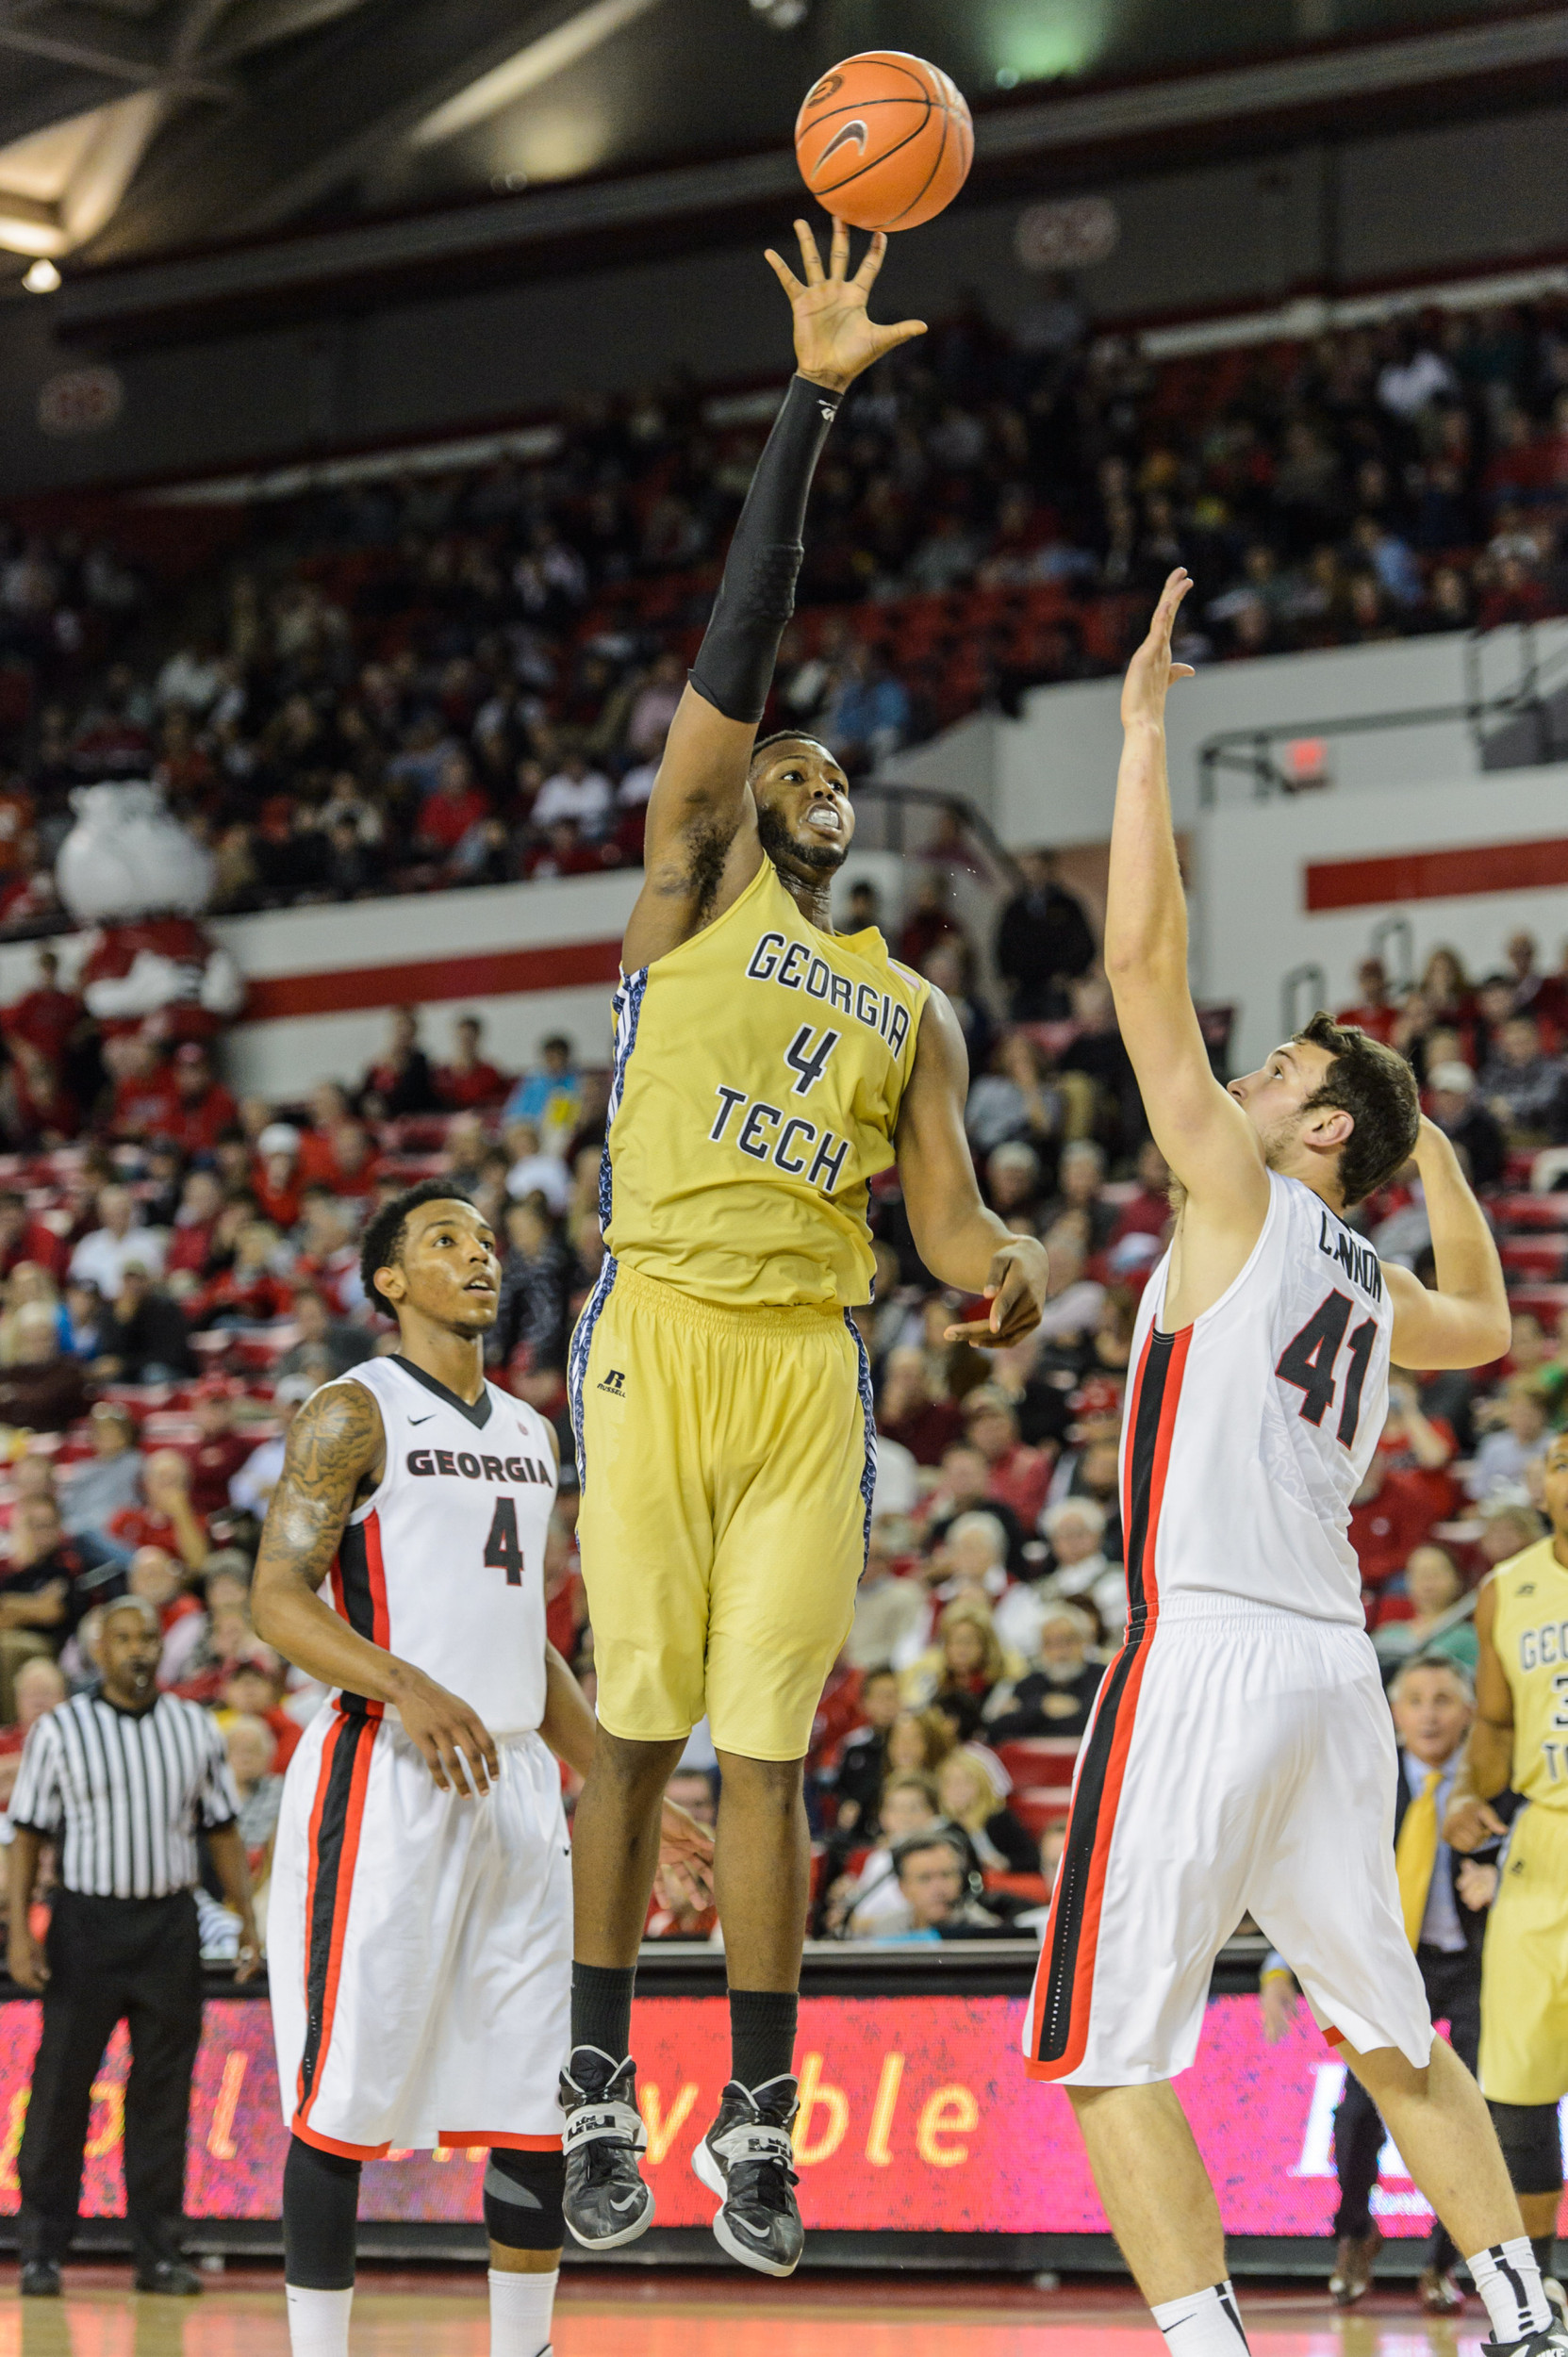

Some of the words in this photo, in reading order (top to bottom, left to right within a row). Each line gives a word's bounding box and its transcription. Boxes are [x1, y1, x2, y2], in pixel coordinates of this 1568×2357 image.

[745, 931, 910, 1062] GEORGIA
[784, 1022, 843, 1097] 4
[707, 1084, 850, 1195] TECH
[596, 1382, 626, 1398] RUSSELL
[1275, 1288, 1378, 1451] 41
[406, 1449, 553, 1488] GEORGIA
[484, 1496, 524, 1587] 4
